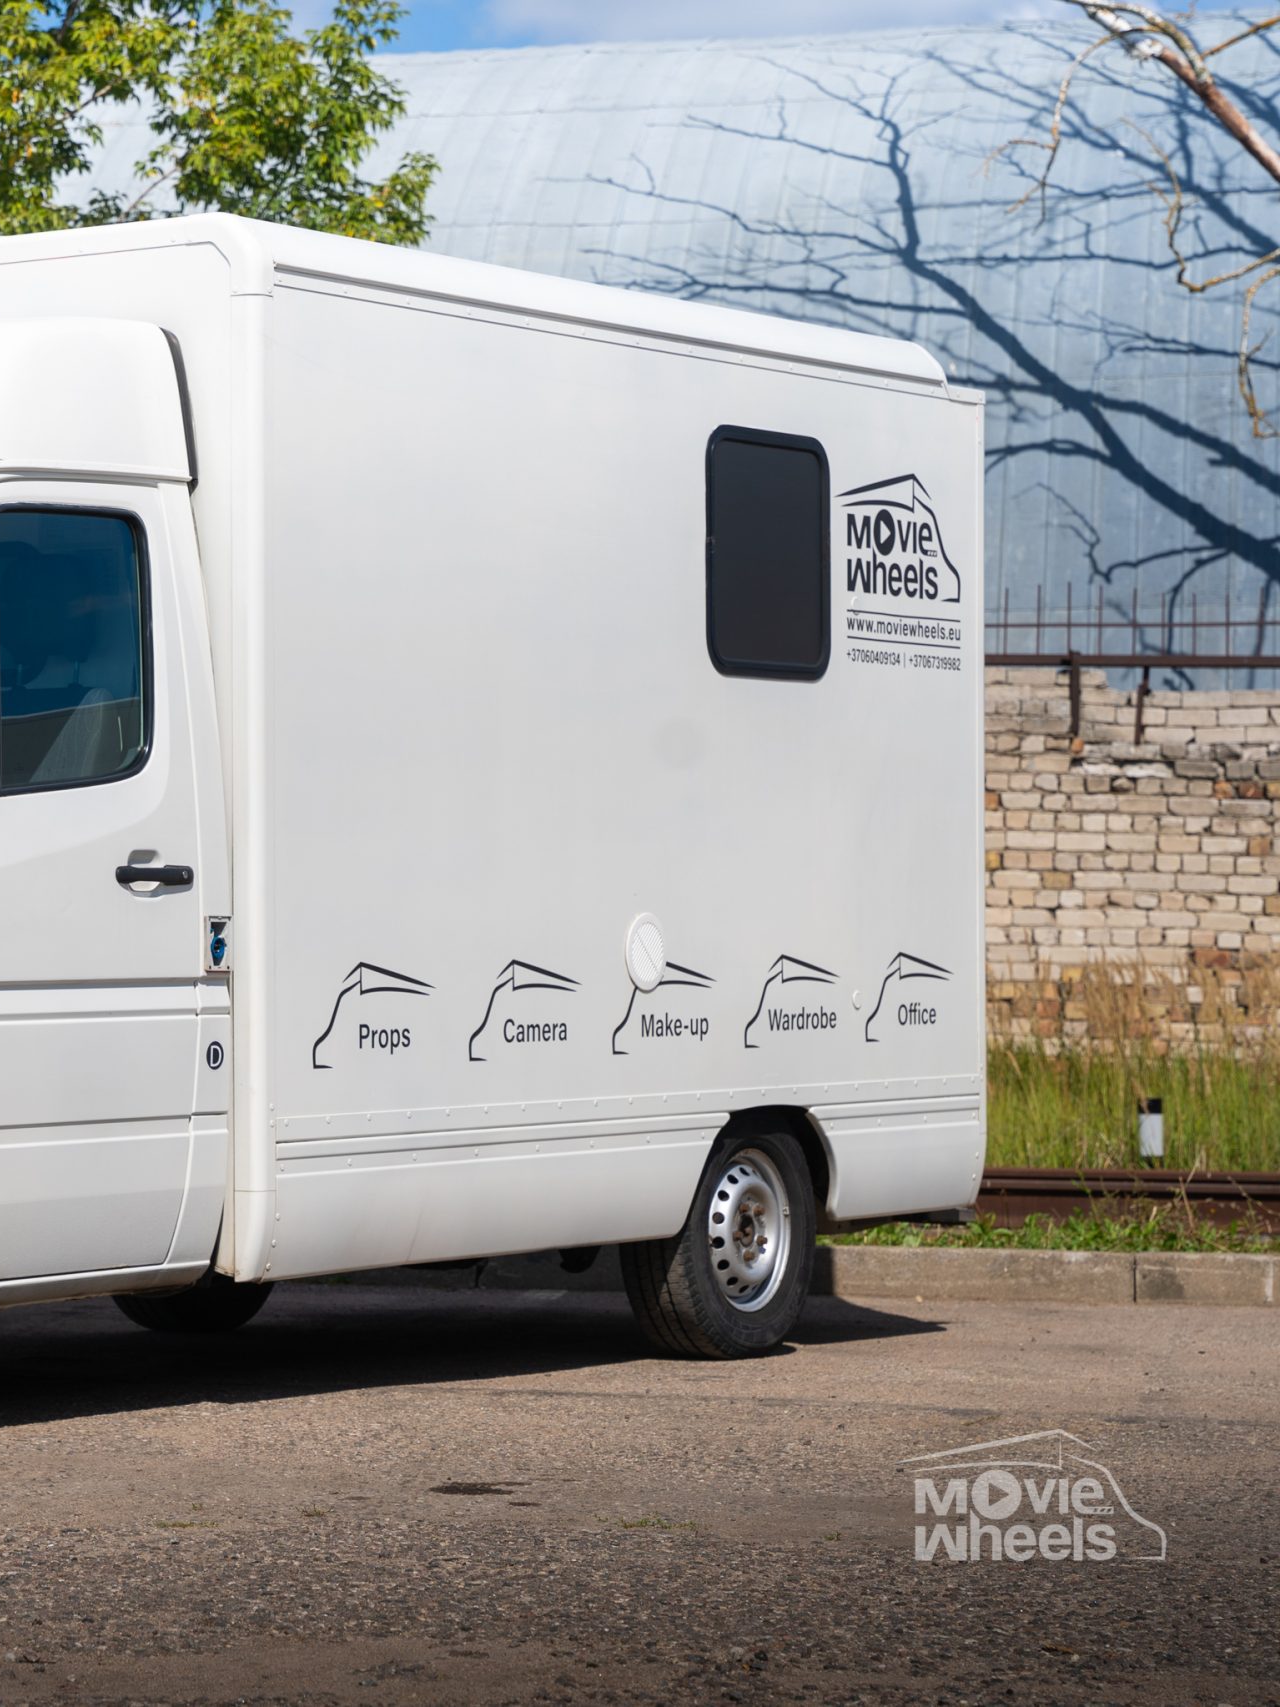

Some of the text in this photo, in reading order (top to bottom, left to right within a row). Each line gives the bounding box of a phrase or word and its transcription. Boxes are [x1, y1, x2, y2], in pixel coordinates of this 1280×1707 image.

[847, 617, 960, 641] www.moviewheels.eu
[641, 1012, 709, 1041] Make-up
[768, 1006, 837, 1031] Wardrobe
[897, 1002, 937, 1026] Office
[359, 1023, 411, 1055] Props
[503, 1018, 568, 1043] Camera
